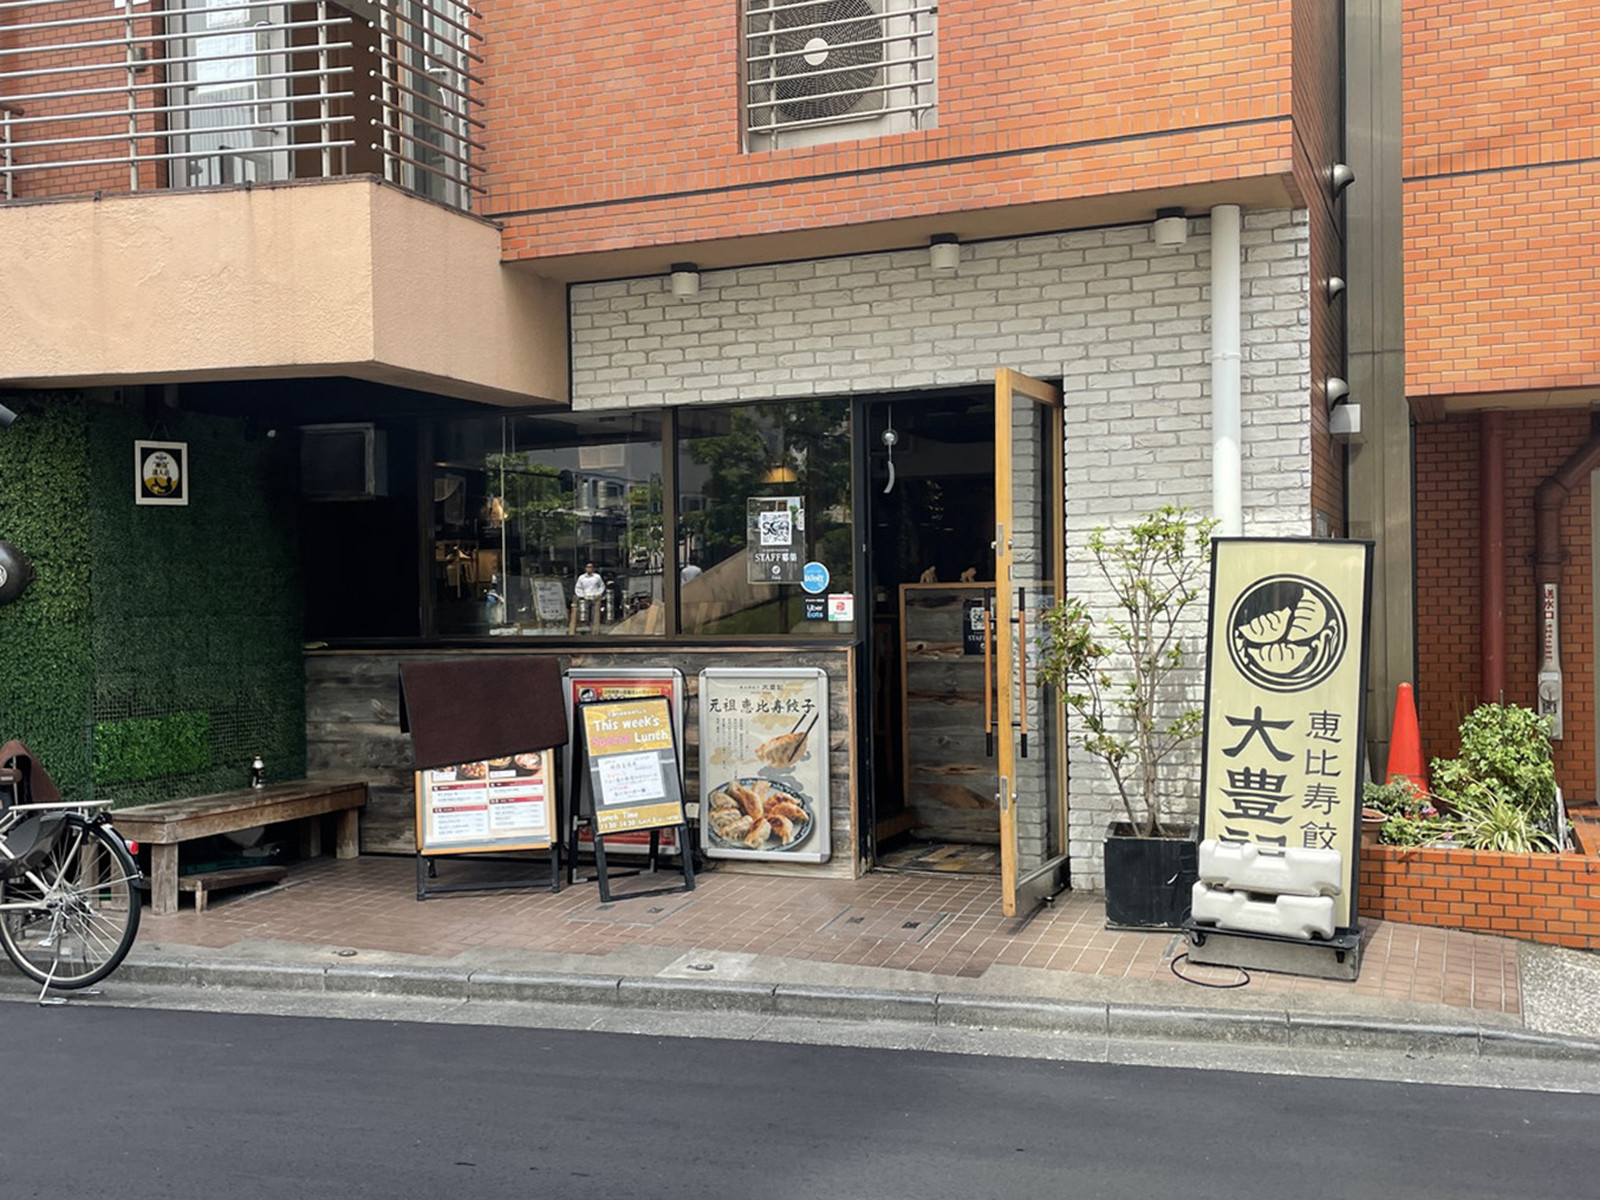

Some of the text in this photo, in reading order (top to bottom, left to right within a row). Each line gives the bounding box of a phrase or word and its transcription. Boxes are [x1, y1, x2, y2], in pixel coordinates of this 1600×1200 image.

[806, 604, 823, 612] Uber
[806, 611, 823, 619] Eats
[593, 719, 619, 731] This
[634, 730, 669, 743] Lunch
